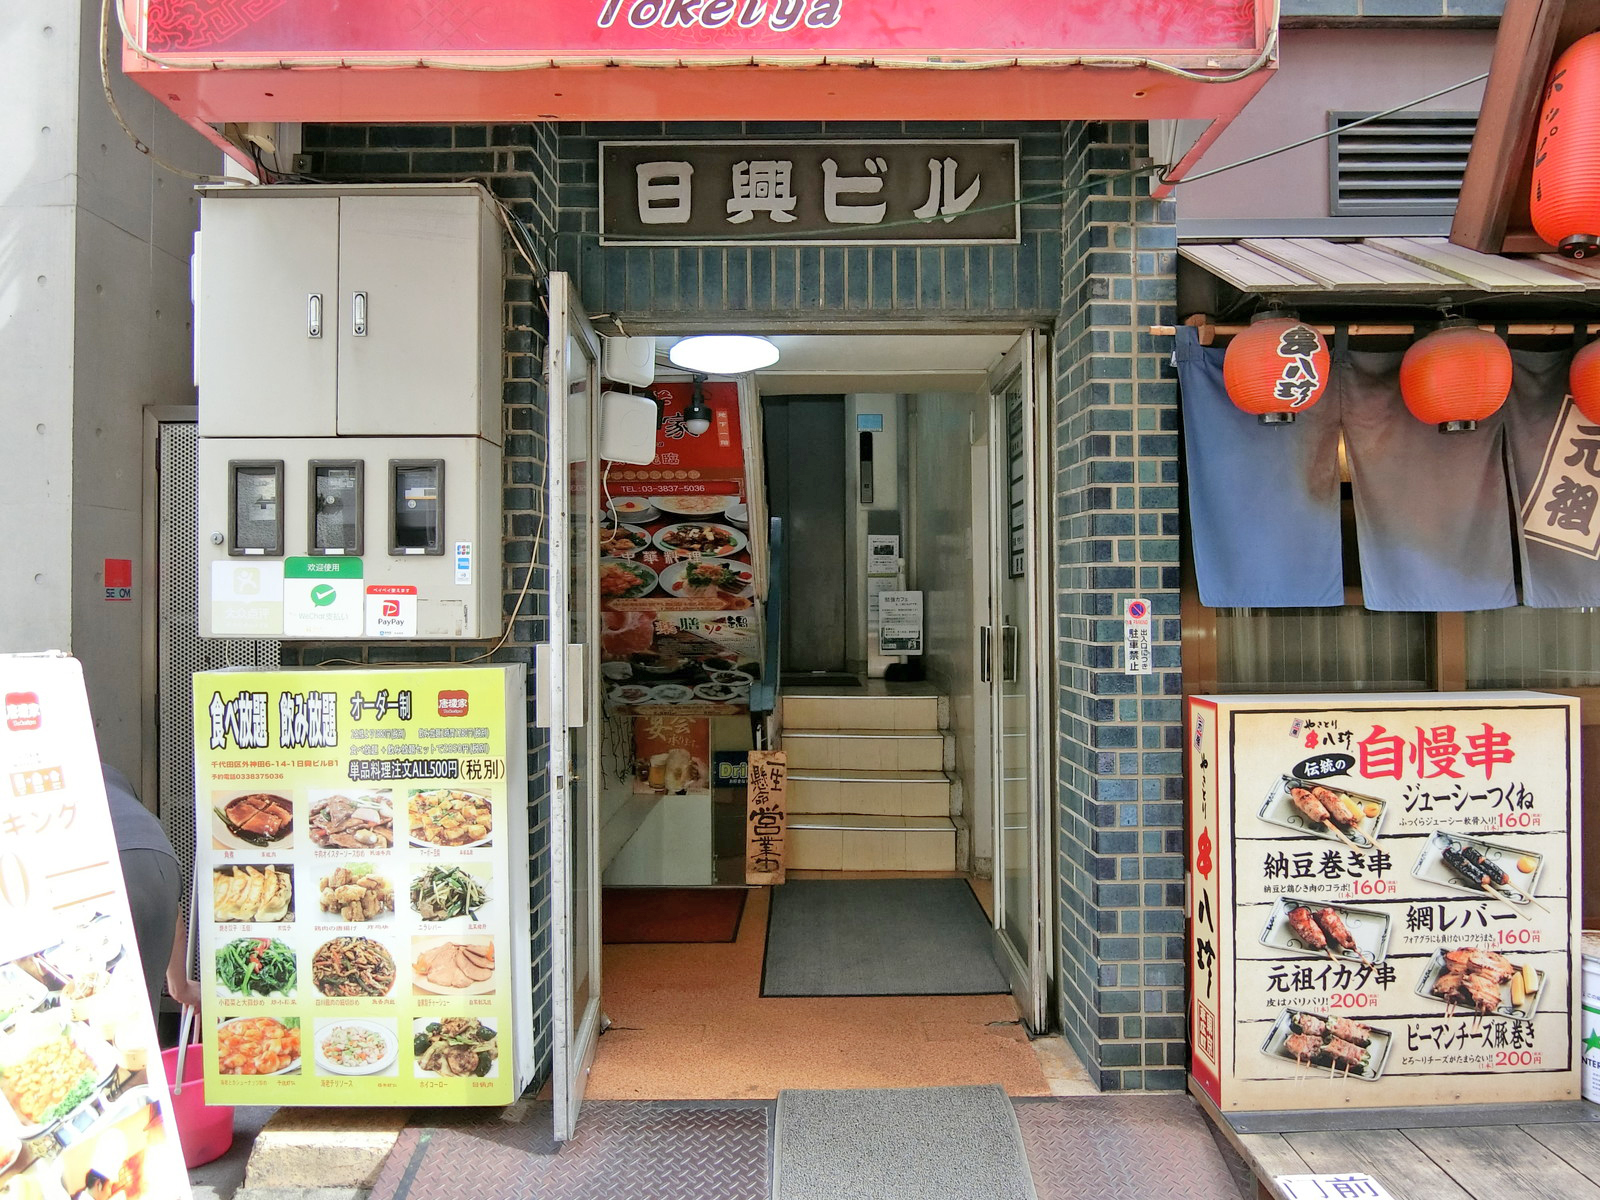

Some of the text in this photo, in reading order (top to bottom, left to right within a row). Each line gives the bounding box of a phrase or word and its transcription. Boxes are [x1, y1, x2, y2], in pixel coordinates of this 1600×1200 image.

[635, 157, 981, 225] 日興ビル
[307, 563, 340, 572] 欢迎使用
[106, 588, 131, 598] SEOM
[377, 618, 405, 627] PayPay
[1128, 628, 1140, 672] 駐車禁止
[209, 690, 269, 750] 食べ放題
[279, 690, 338, 750] 飲み放題
[350, 688, 412, 721] オーダー制
[1304, 718, 1338, 730] やきとり
[1356, 722, 1516, 781] 自慢串
[1304, 758, 1347, 777] 伝統の
[1402, 781, 1535, 813] ジューシーつくね
[1263, 849, 1393, 880] 納豆巻き串
[1406, 903, 1518, 933] 網レバー
[1330, 992, 1378, 1009] 200円
[1407, 1018, 1536, 1052] ピーマンチーズ豚巻き
[1495, 1050, 1542, 1067] 200円
